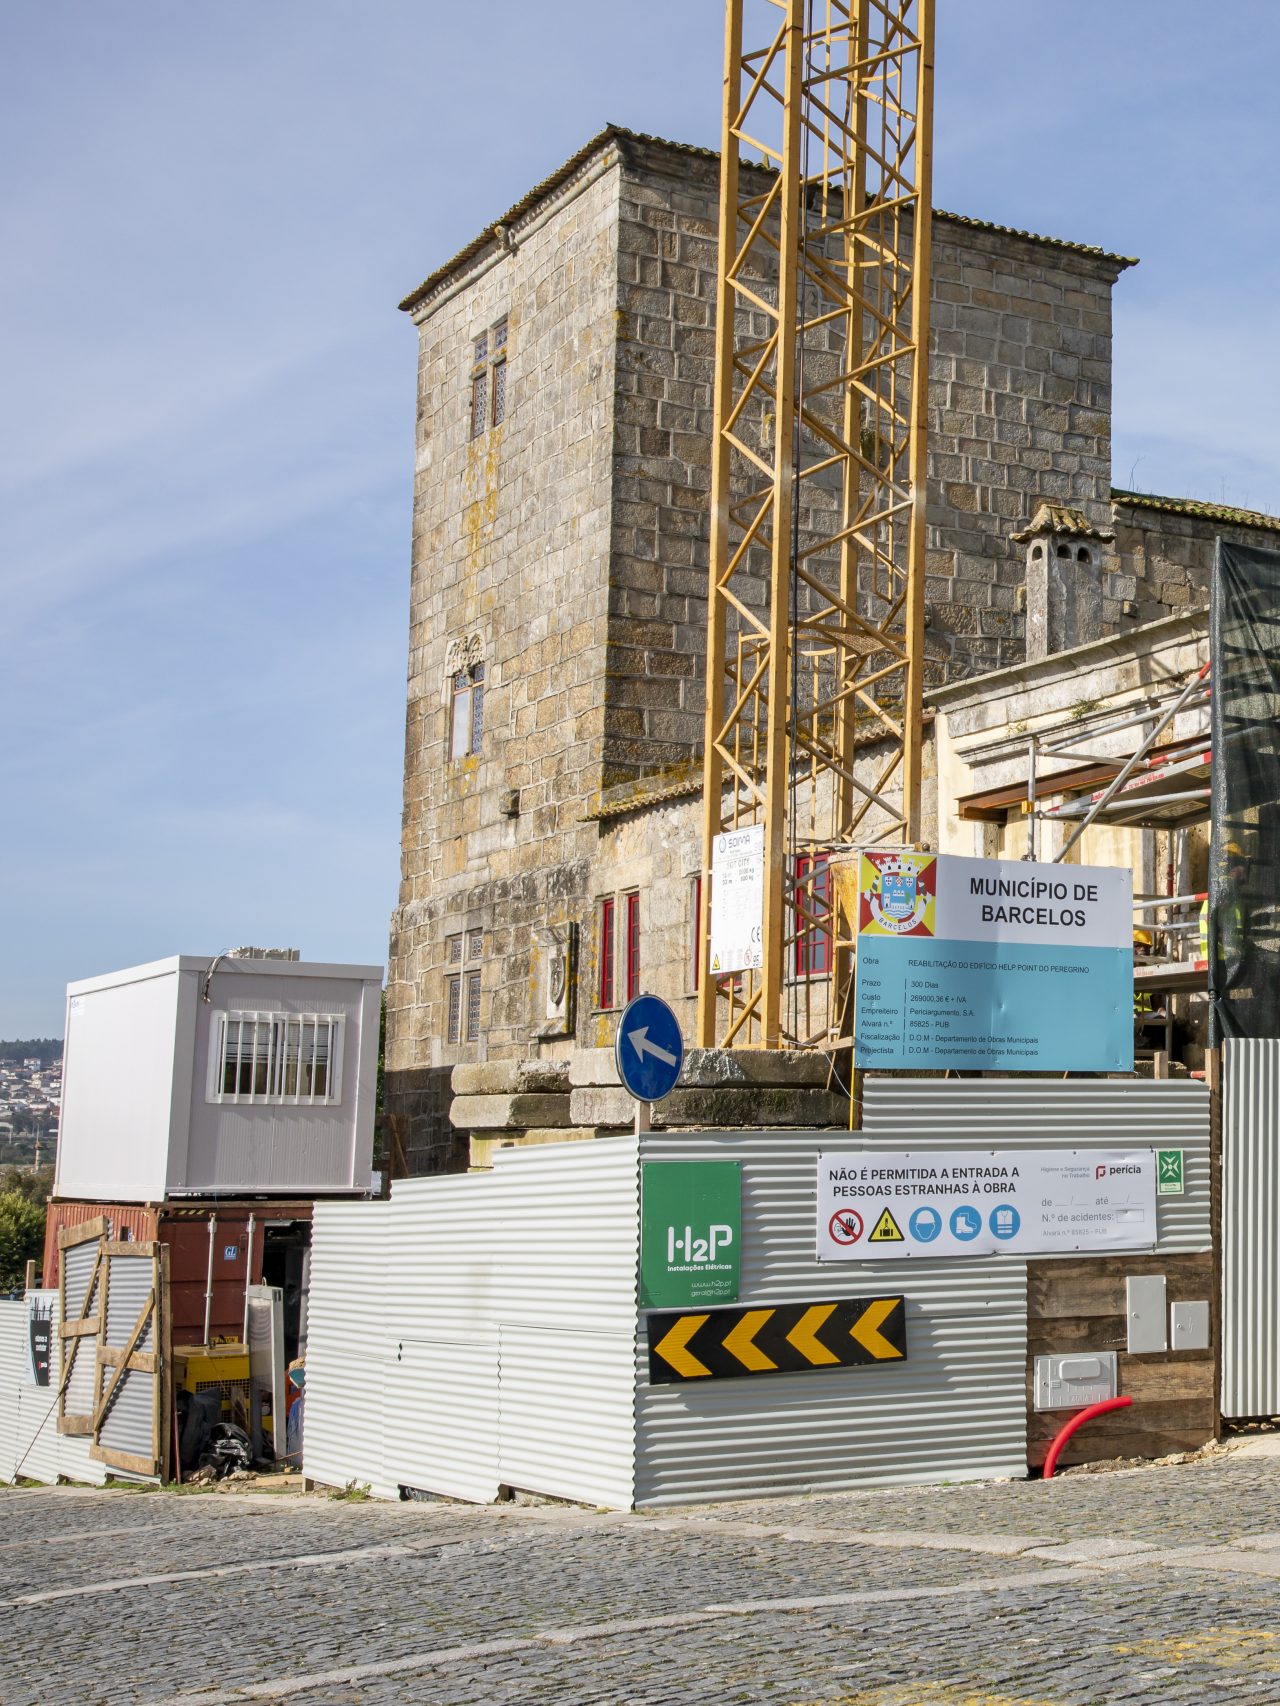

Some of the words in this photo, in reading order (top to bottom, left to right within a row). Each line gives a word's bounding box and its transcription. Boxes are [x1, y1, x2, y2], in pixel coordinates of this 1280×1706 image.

[969, 876, 1068, 900] MUNICÍPIO
[1073, 883, 1098, 902] DE
[981, 904, 1086, 927] BARCELOS
[878, 917, 917, 930] BARCELOS
[862, 957, 879, 965] Obra
[908, 958, 957, 970] REABILITAÇÃO
[958, 961, 969, 969] DO
[969, 961, 997, 970] EDIFÍCIO
[998, 963, 1017, 971] HELP
[1017, 964, 1038, 972] POINT
[1050, 965, 1090, 974] PEREGRINO
[861, 979, 881, 987] Prazo
[911, 980, 924, 988] 300
[861, 993, 881, 1001] Custo
[944, 995, 950, 1003] €
[861, 1006, 899, 1015] Empreiteiro
[962, 1009, 975, 1017] S.A.
[909, 1020, 930, 1028] 85825
[860, 1032, 901, 1042] Fiscalização
[935, 1035, 978, 1044] Departamento
[987, 1036, 1006, 1044] Obras
[1007, 1036, 1039, 1046] Municipais
[860, 1046, 894, 1055] Projectista
[934, 1047, 977, 1057] Departamento
[987, 1048, 1006, 1056] Obras
[1007, 1048, 1039, 1058] Municipais
[829, 1167, 857, 1181] NÃO
[861, 1166, 868, 1180] É
[871, 1168, 937, 1180] PERMITIDA
[940, 1167, 949, 1179] A
[952, 1166, 1008, 1179] ENTRADA
[1011, 1166, 1020, 1177] A
[1109, 1164, 1142, 1176] perícia
[833, 1185, 892, 1197] PESSOAS
[895, 1183, 969, 1196] ESTRANHAS
[972, 1180, 981, 1194] À
[984, 1182, 1016, 1194] OBRA
[1041, 1198, 1053, 1207] de
[1095, 1196, 1109, 1206] até
[1041, 1213, 1056, 1223] N.º
[1057, 1213, 1069, 1222] de
[1070, 1212, 1114, 1222] acidentes:
[668, 1225, 733, 1263] H2P
[667, 1264, 704, 1272] Instalações
[691, 1279, 732, 1288] www.h2p.pt
